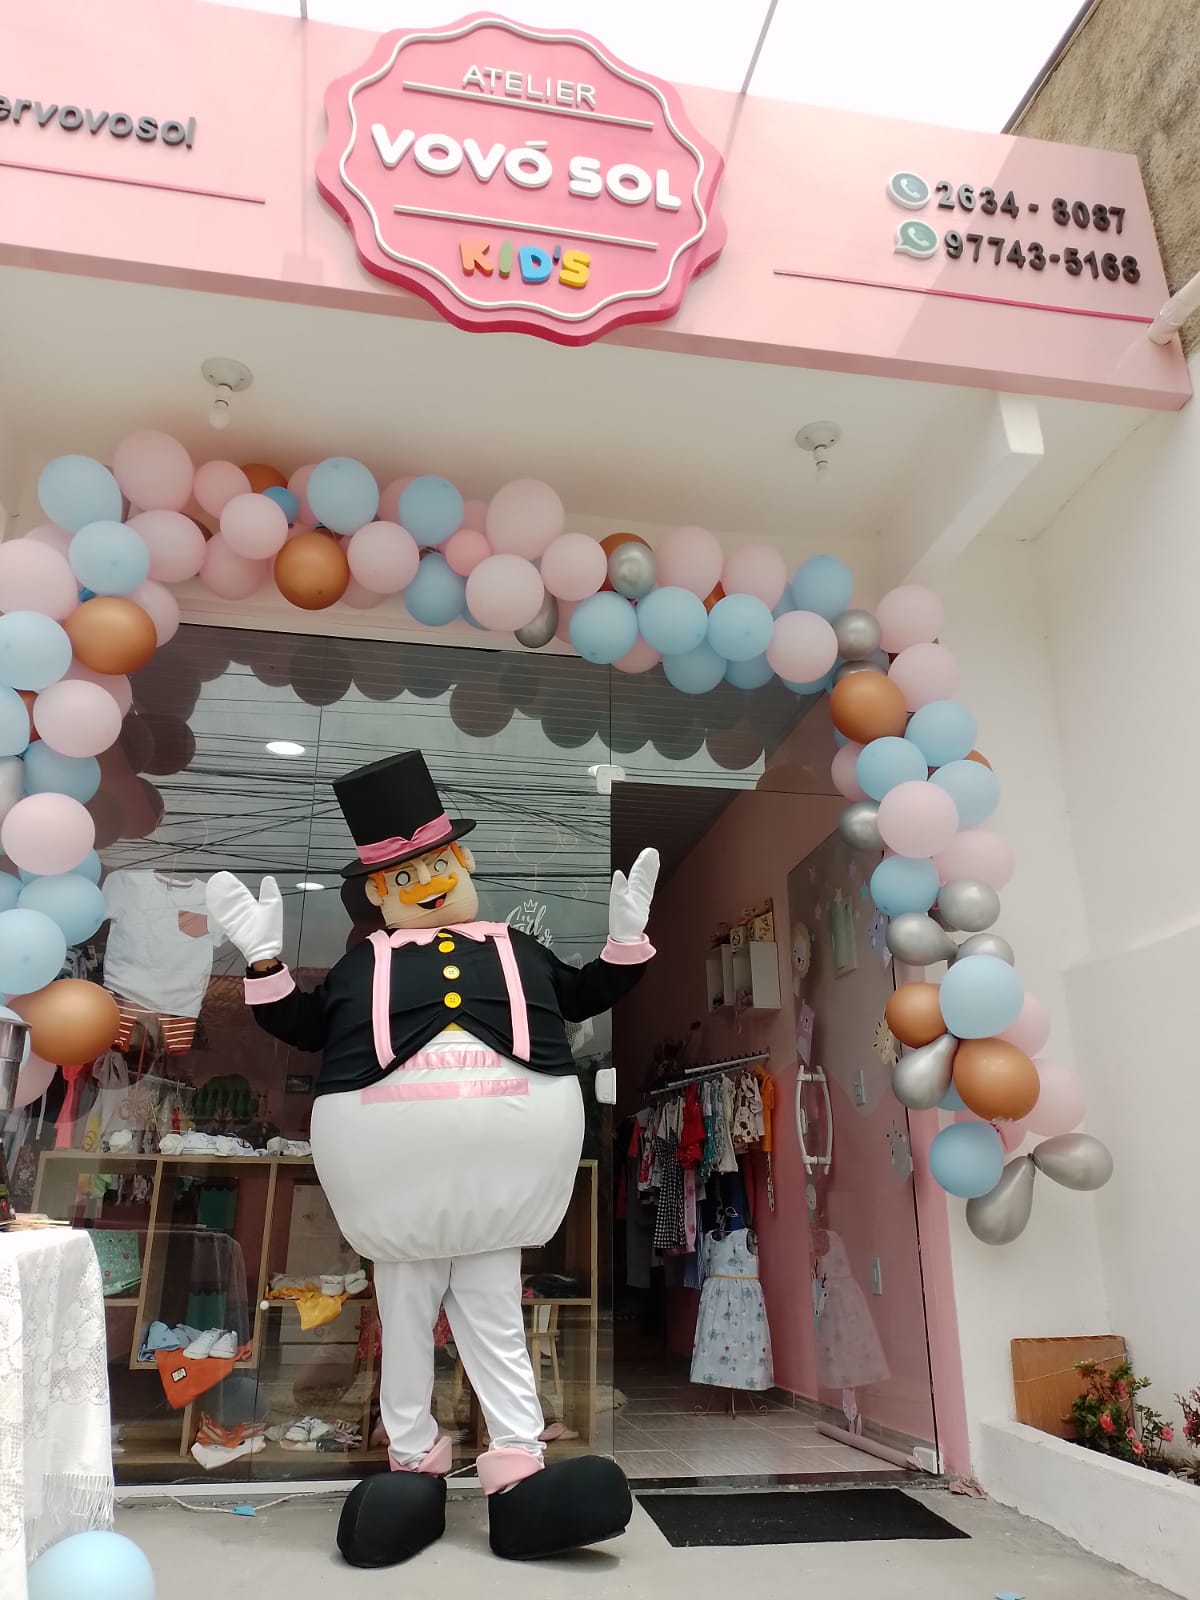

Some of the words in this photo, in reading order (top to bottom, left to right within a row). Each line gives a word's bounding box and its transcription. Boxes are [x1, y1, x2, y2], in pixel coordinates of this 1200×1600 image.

[462, 65, 596, 109] ATELIER
[371, 123, 553, 189] VOVÓ
[568, 157, 681, 211] SOL
[459, 239, 591, 288] KID'S
[943, 229, 1141, 283] 97743-5168
